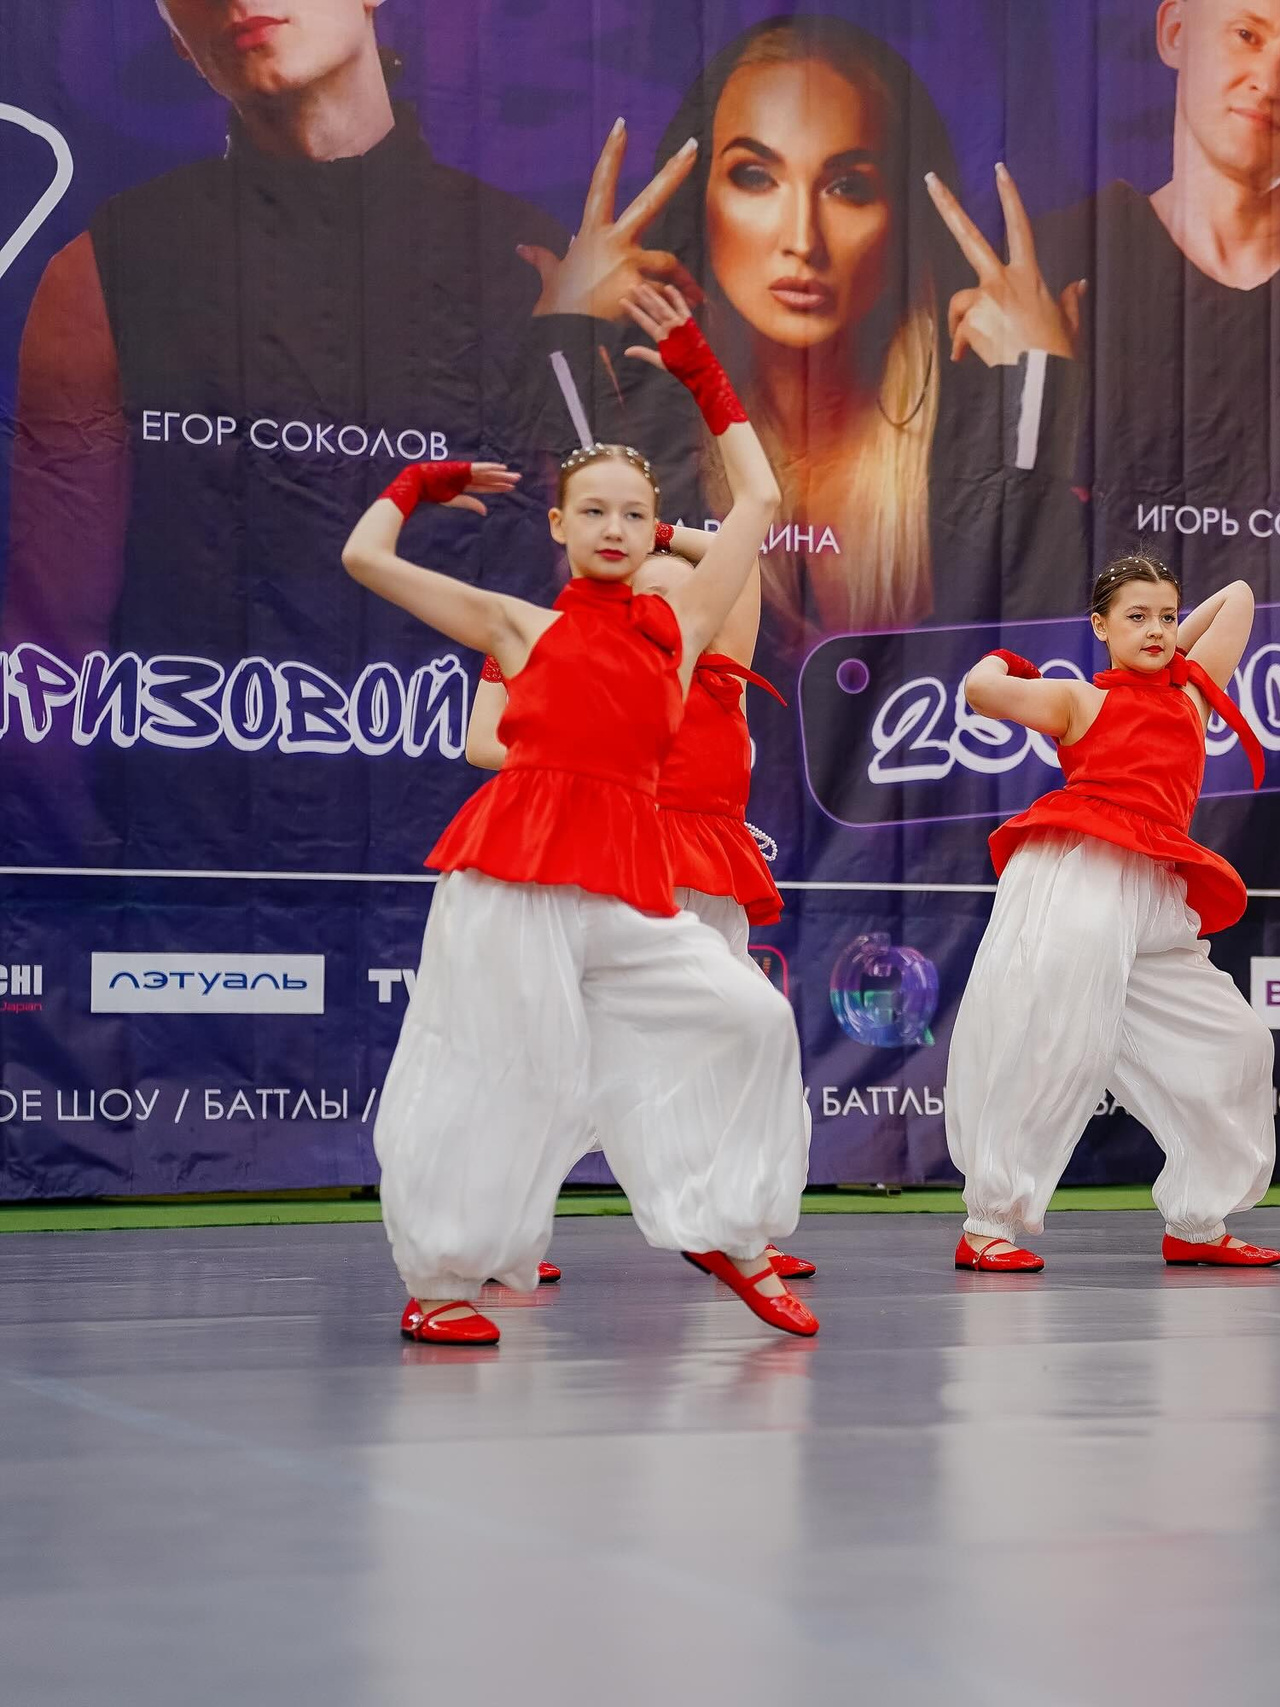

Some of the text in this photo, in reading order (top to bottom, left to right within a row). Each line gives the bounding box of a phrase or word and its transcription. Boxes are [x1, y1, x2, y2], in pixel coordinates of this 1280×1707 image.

[143, 410, 449, 461] ЕГОР СОКОЛОВ
[1137, 503, 1240, 537] ИГОРЬ
[0, 642, 469, 760] РИЗОВОЙ
[57, 1088, 160, 1121] ШОУ
[204, 1089, 348, 1121] БАТТЛЫ
